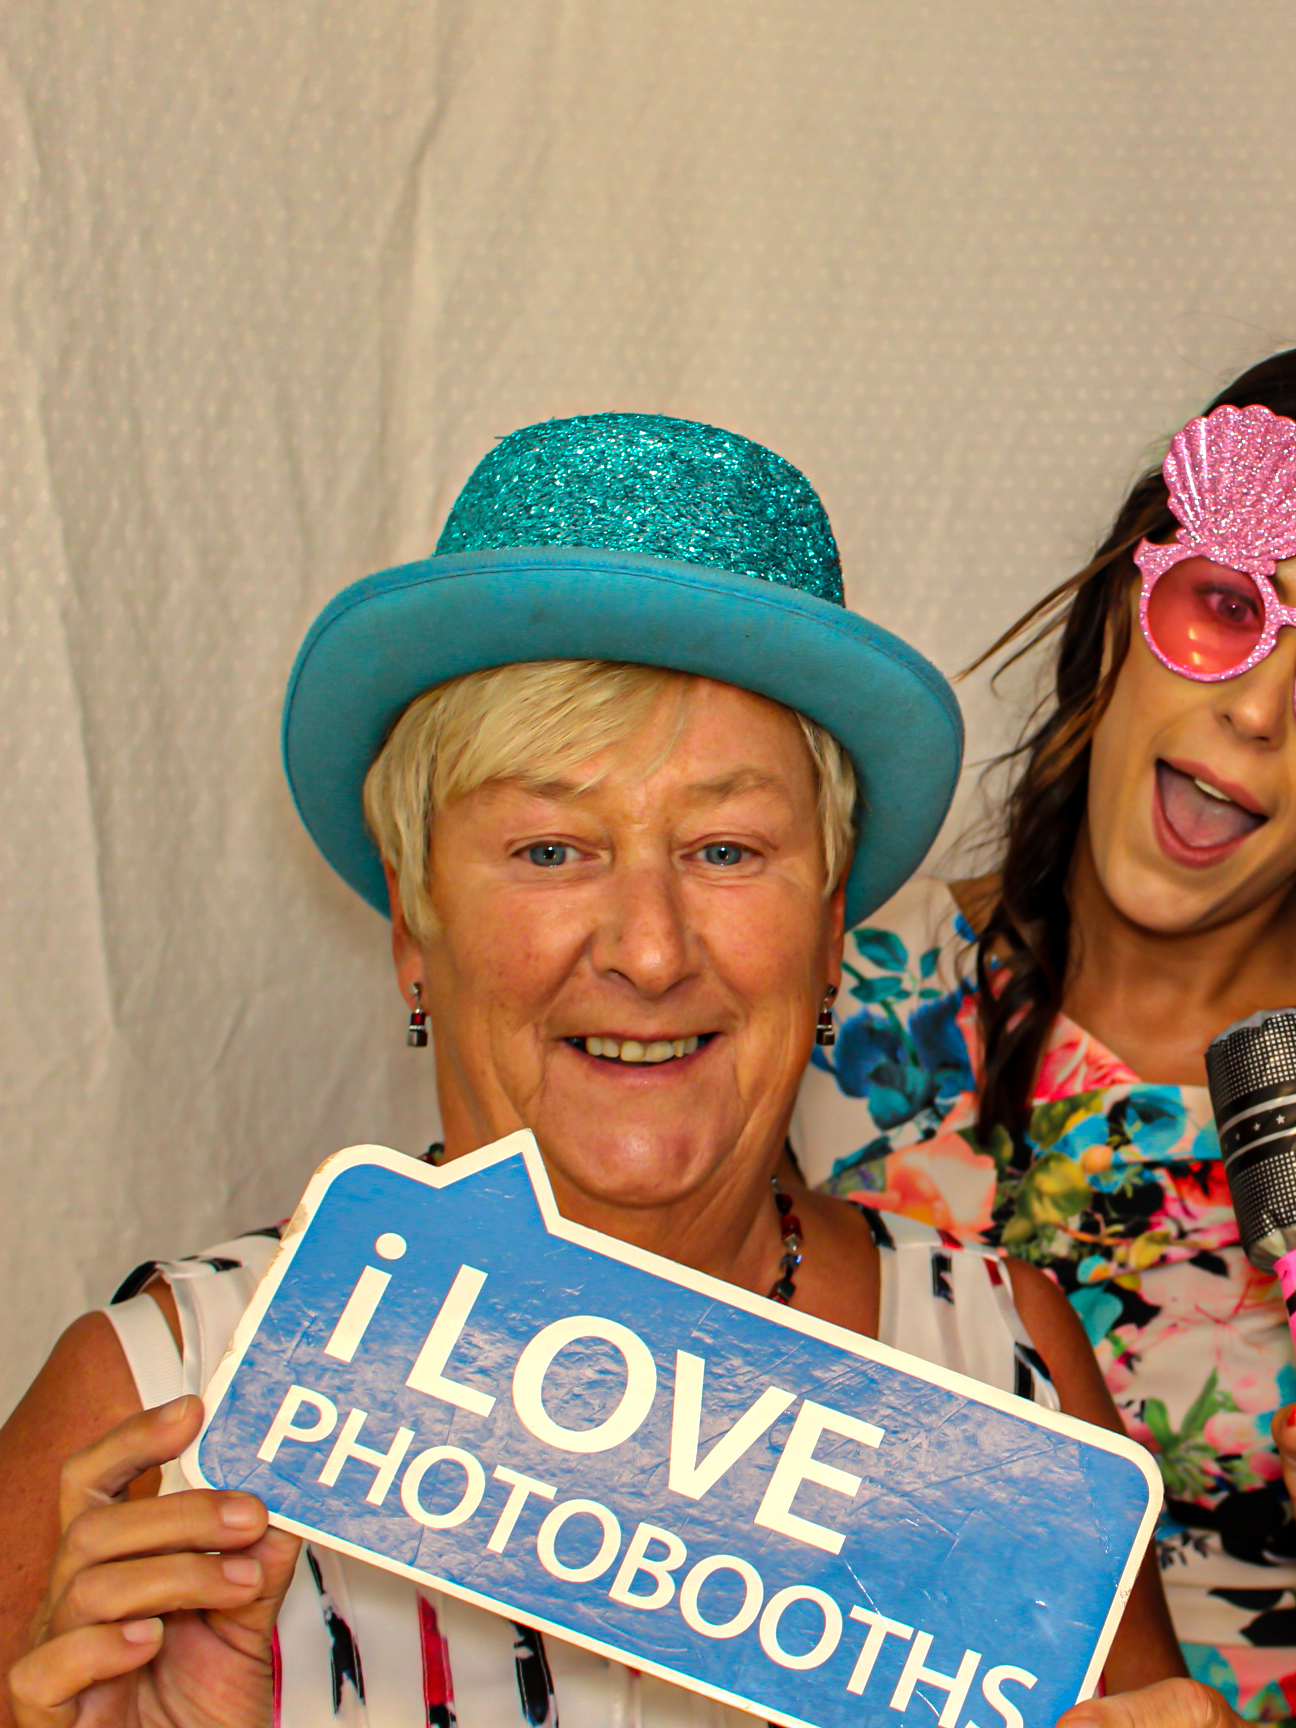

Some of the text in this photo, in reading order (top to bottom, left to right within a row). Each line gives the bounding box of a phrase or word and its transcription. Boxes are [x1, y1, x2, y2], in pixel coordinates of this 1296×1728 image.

[256, 1384, 1039, 1728] PHOTOBOOTHS
[323, 1232, 885, 1555] i LOVE
